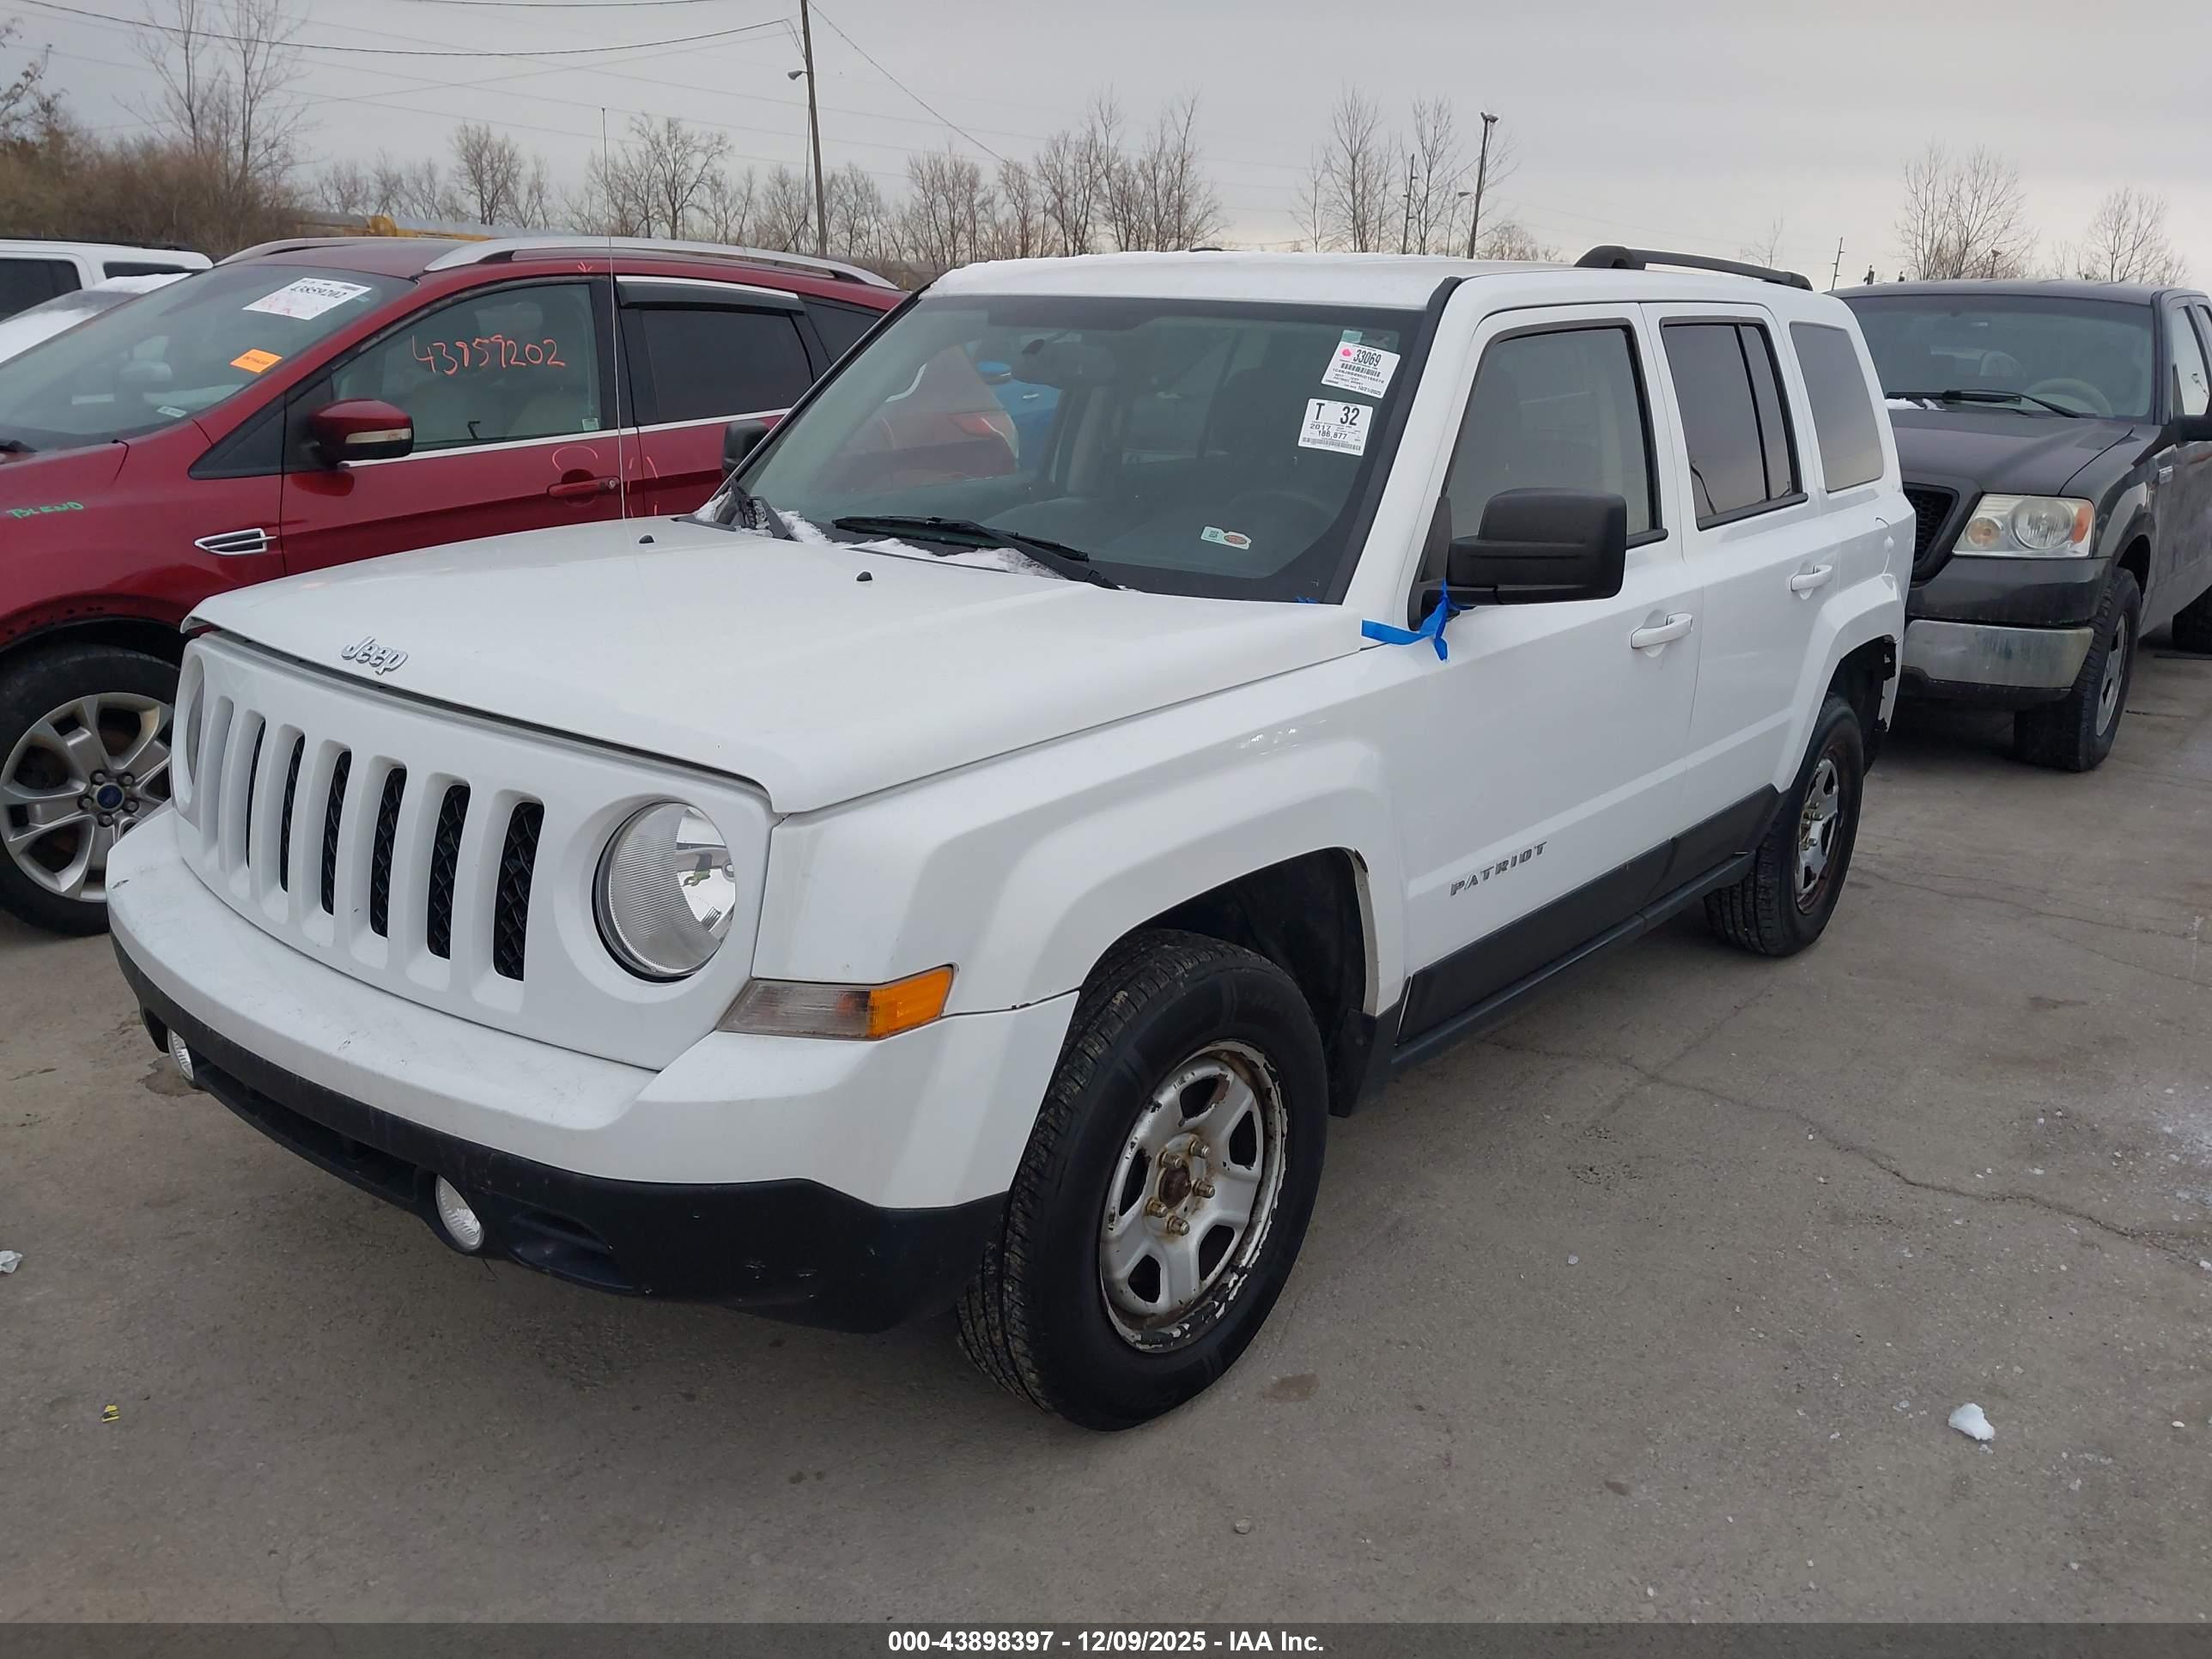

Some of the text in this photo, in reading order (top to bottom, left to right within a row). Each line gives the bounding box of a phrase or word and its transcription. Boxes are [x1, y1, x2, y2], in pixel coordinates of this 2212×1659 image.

[1352, 349, 1382, 367] 33069
[1316, 403, 1325, 421] T
[1340, 405, 1360, 426] 32
[1310, 422, 1331, 431] 2017
[341, 636, 409, 675] Jeep
[1449, 842, 1547, 896] PATRIOT
